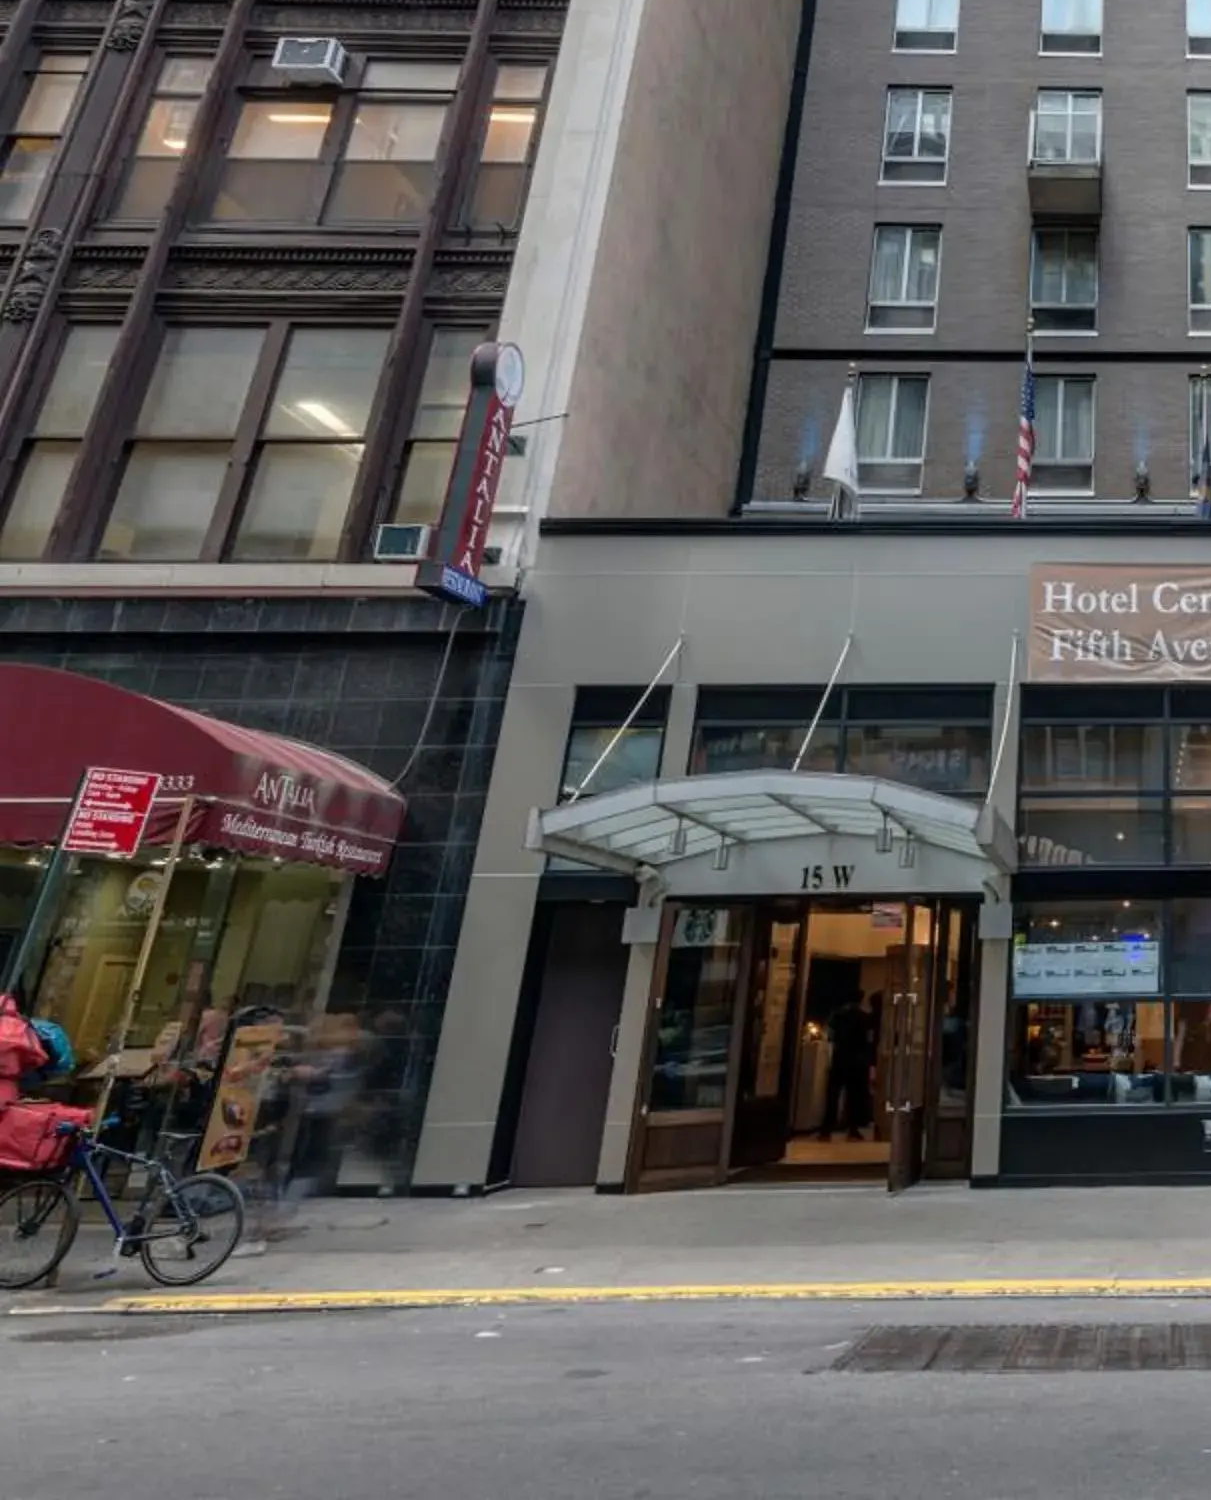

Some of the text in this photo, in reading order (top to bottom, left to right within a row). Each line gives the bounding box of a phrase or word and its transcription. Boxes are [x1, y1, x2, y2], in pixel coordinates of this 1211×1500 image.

[460, 405, 506, 576] ANTALIA
[1042, 581, 1140, 614] Hotel
[1050, 628, 1135, 662] Fifth
[800, 864, 855, 890] 15 W
